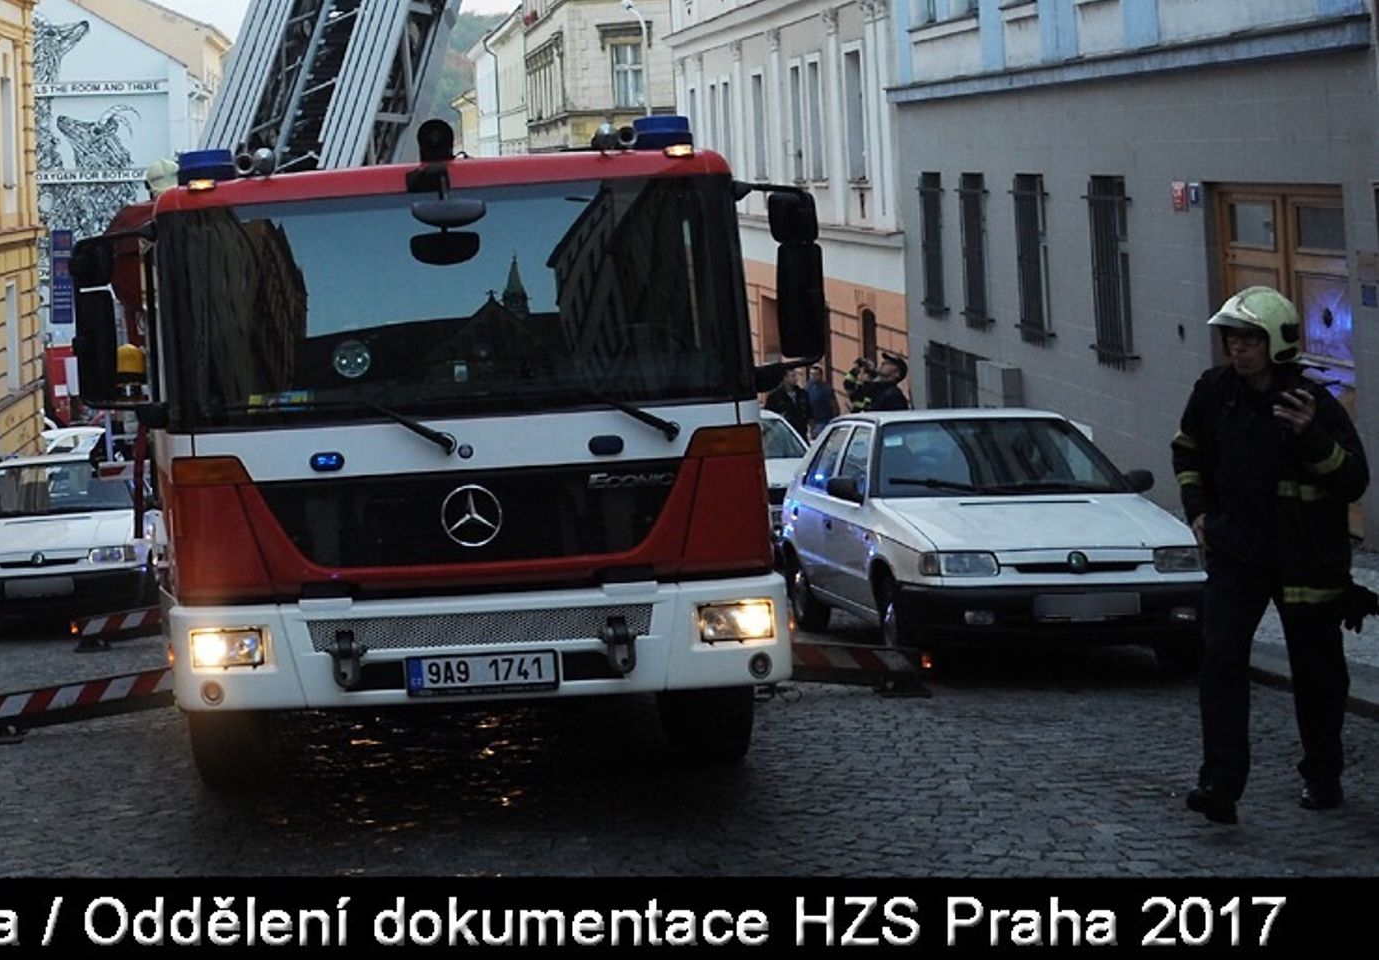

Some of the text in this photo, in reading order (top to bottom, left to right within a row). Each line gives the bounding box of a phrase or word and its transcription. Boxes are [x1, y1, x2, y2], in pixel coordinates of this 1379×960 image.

[51, 85, 67, 94] THE
[71, 83, 101, 93] ROOM
[103, 82, 125, 92] AND
[127, 81, 160, 91] THERE
[36, 171, 77, 181] OXYGEN
[79, 170, 99, 180] FOR
[102, 169, 131, 179] BOTH
[427, 656, 544, 685] 9A9 1741
